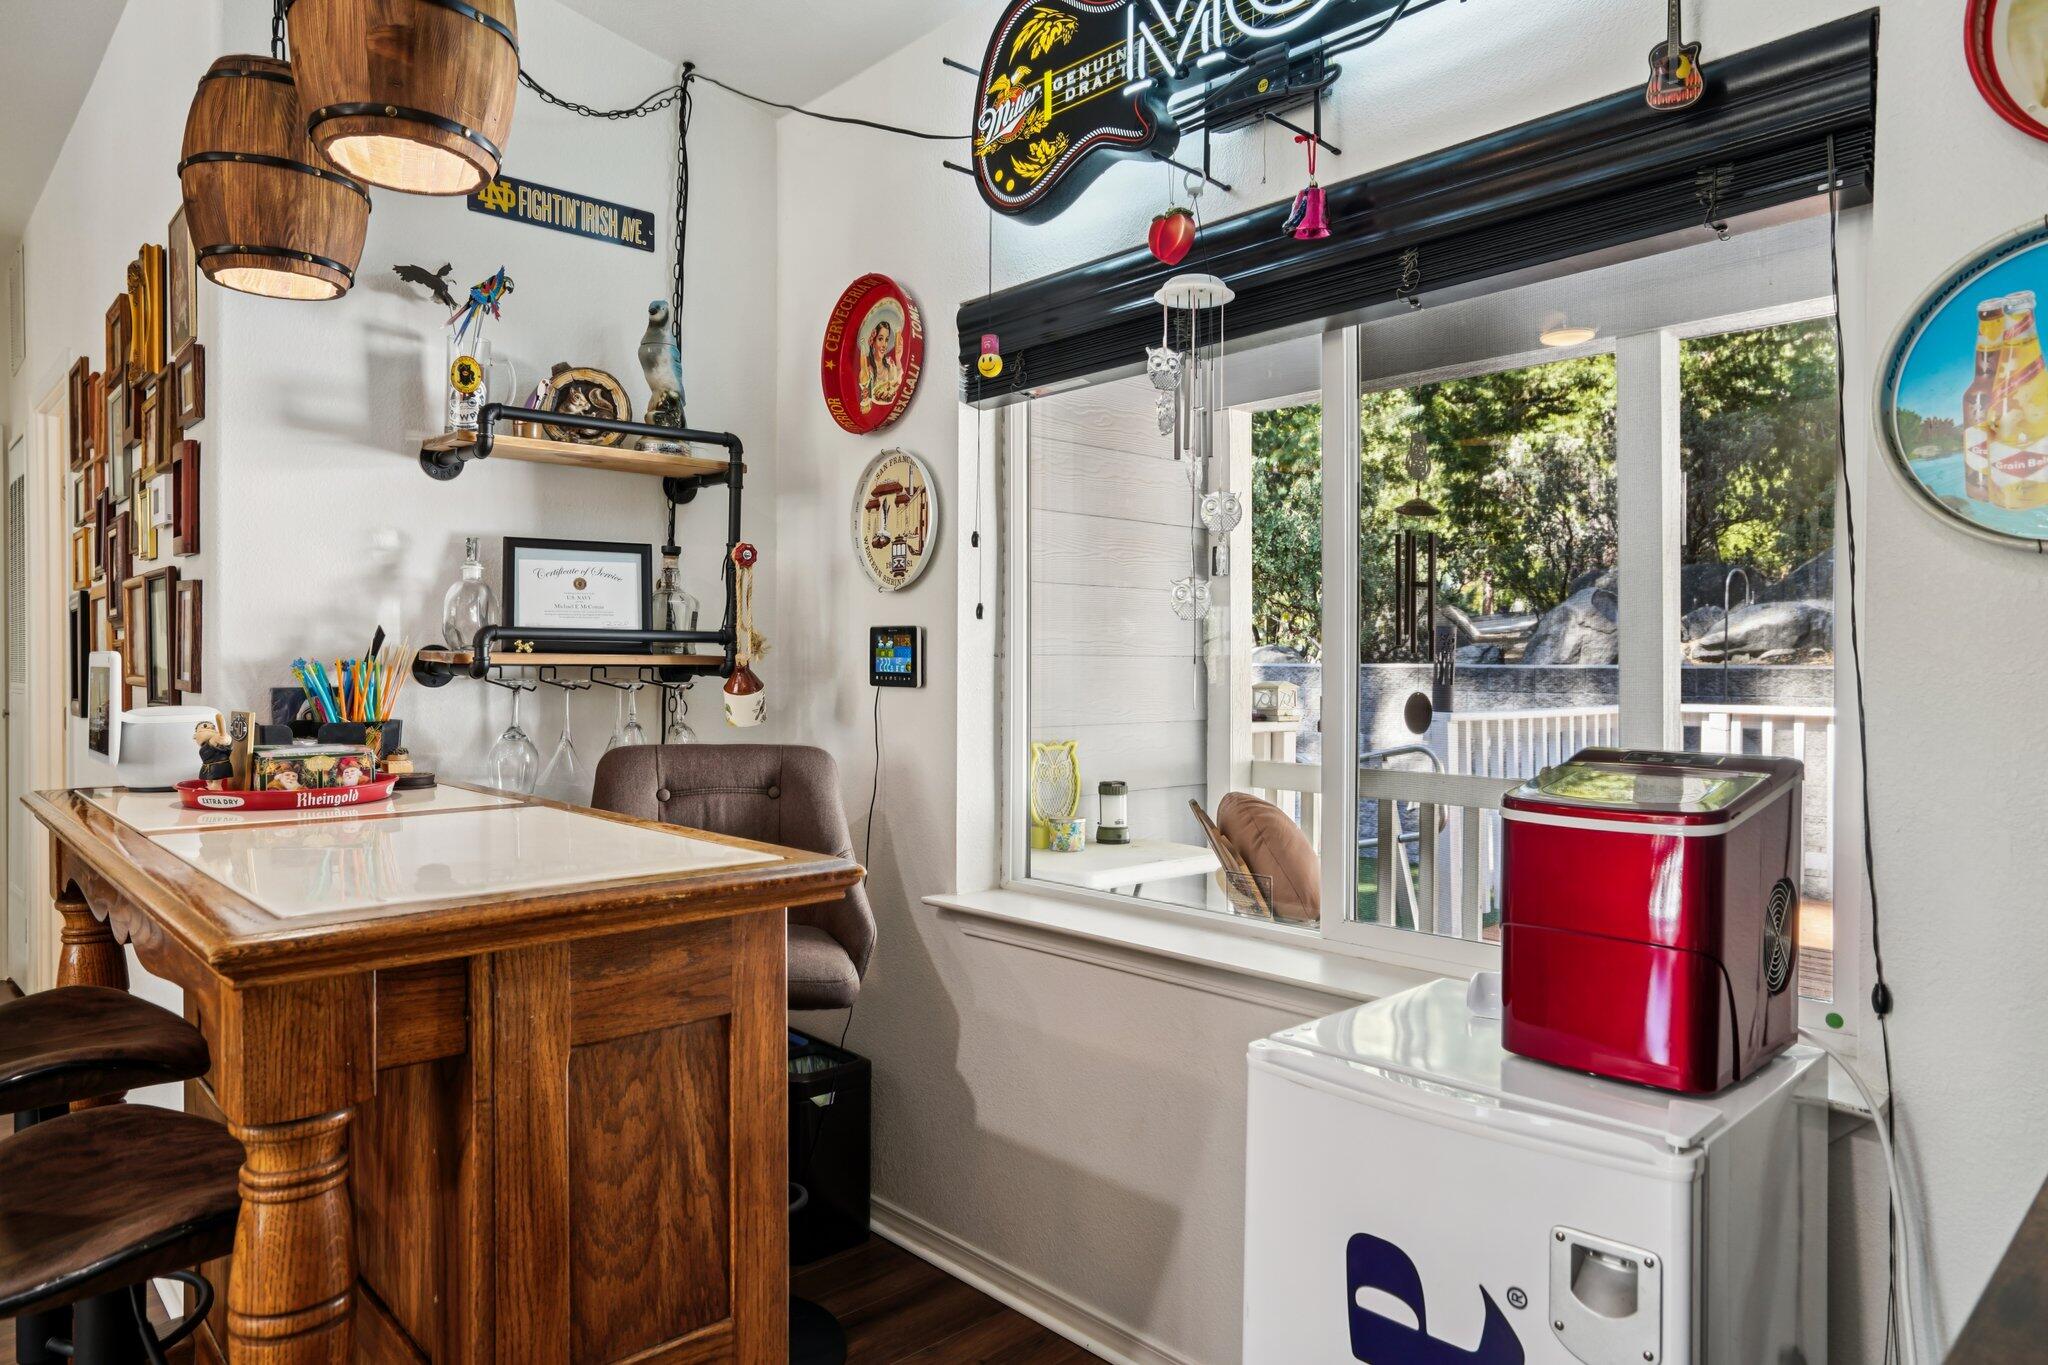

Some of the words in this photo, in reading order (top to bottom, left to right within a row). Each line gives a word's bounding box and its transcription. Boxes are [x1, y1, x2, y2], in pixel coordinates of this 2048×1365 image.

[1065, 62, 1128, 102] DRAFT
[978, 84, 1043, 145] Miller
[518, 185, 581, 230] FIGHTIN'
[581, 200, 619, 239] IRISH
[621, 215, 647, 246] AVE.
[875, 462, 888, 480] SAN
[1995, 461, 2026, 470] Grain
[202, 797, 222, 805] EXTRA
[296, 788, 359, 808] Rheingold
